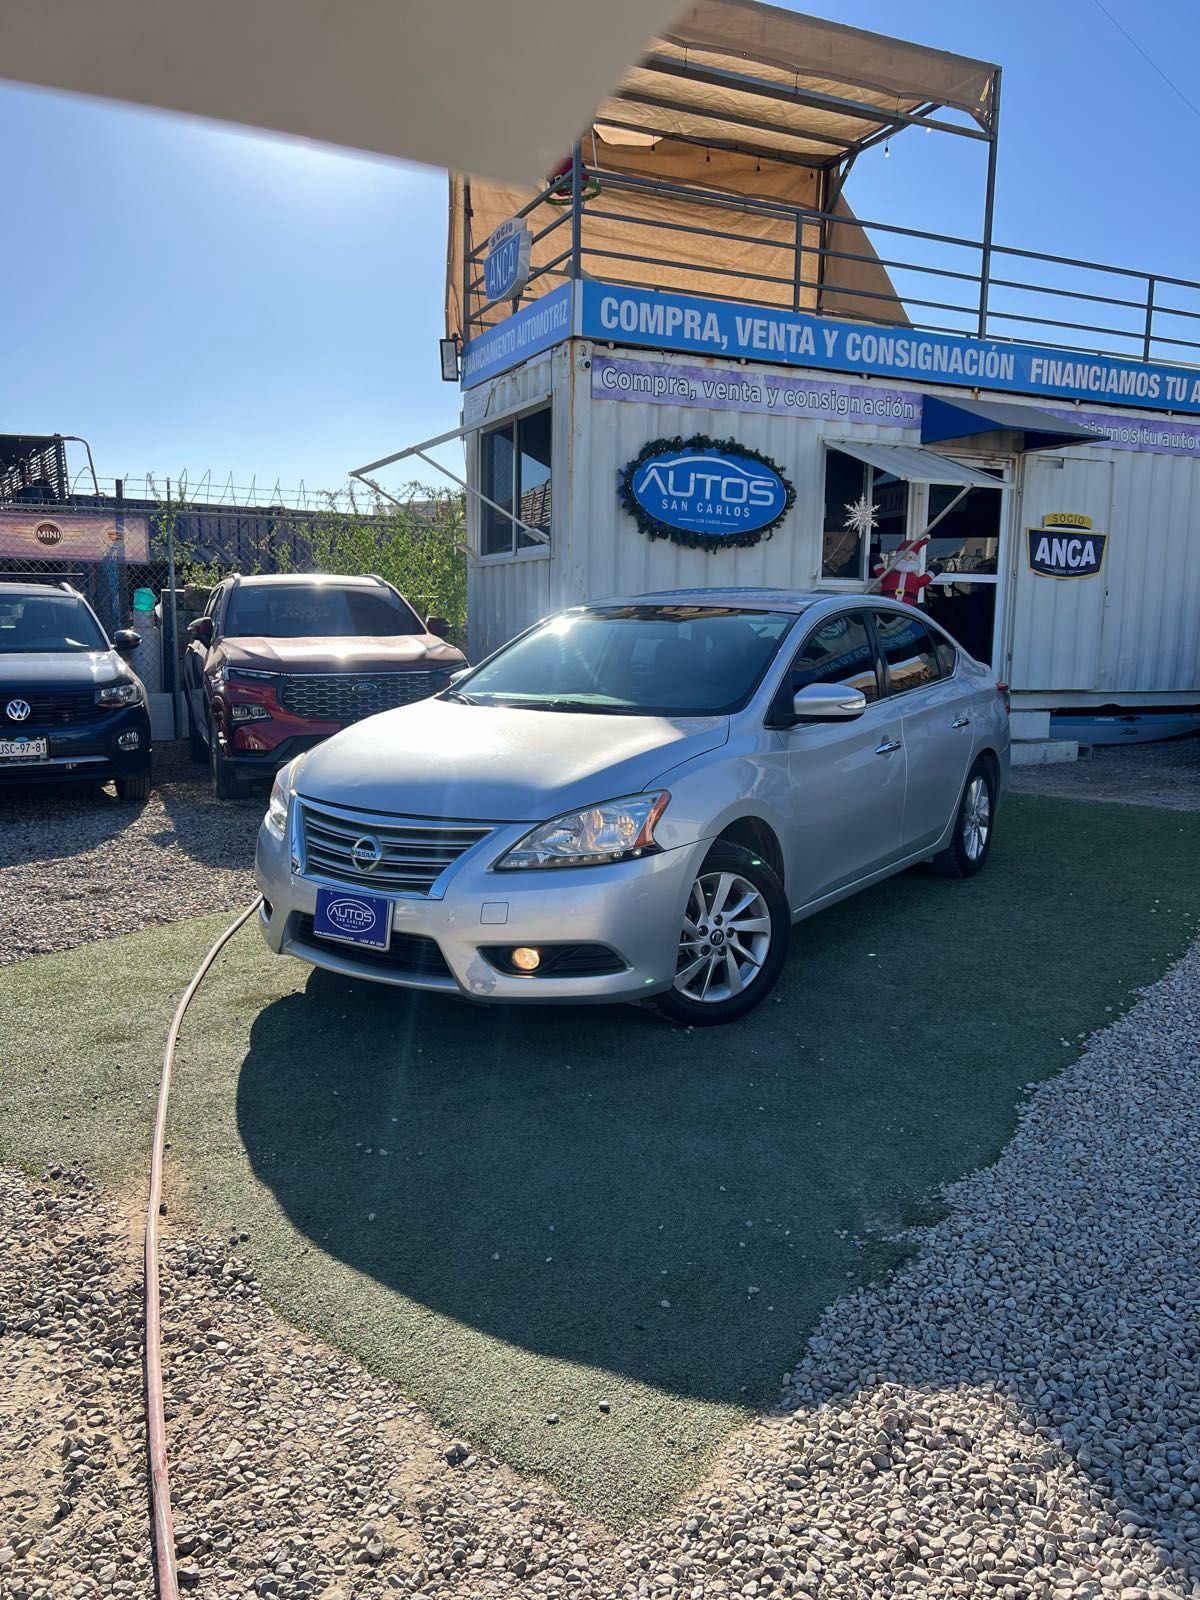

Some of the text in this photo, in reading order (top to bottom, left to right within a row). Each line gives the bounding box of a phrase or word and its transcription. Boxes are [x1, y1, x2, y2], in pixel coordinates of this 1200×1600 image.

[490, 243, 514, 297] ANCA
[517, 298, 568, 346] AUTOMOTRIZ
[601, 297, 728, 349] COMPRA,
[735, 316, 816, 356] VENTA
[823, 328, 839, 358] Y
[846, 333, 1015, 381] CONSIGNACIÓN
[1030, 358, 1161, 399] FINANCIAMOS
[1166, 376, 1188, 402] TU
[602, 367, 697, 399] Compra,
[703, 380, 761, 403] venta
[767, 386, 779, 407] y
[784, 385, 914, 420] consignación
[1143, 427, 1158, 446] tu
[638, 467, 775, 507] AUTOS
[661, 499, 751, 518] SAN CARLOS
[1053, 513, 1085, 525] SOCIO
[37, 529, 61, 539] MINI
[1035, 537, 1097, 568] ANCA
[329, 906, 372, 922] AUTOS
